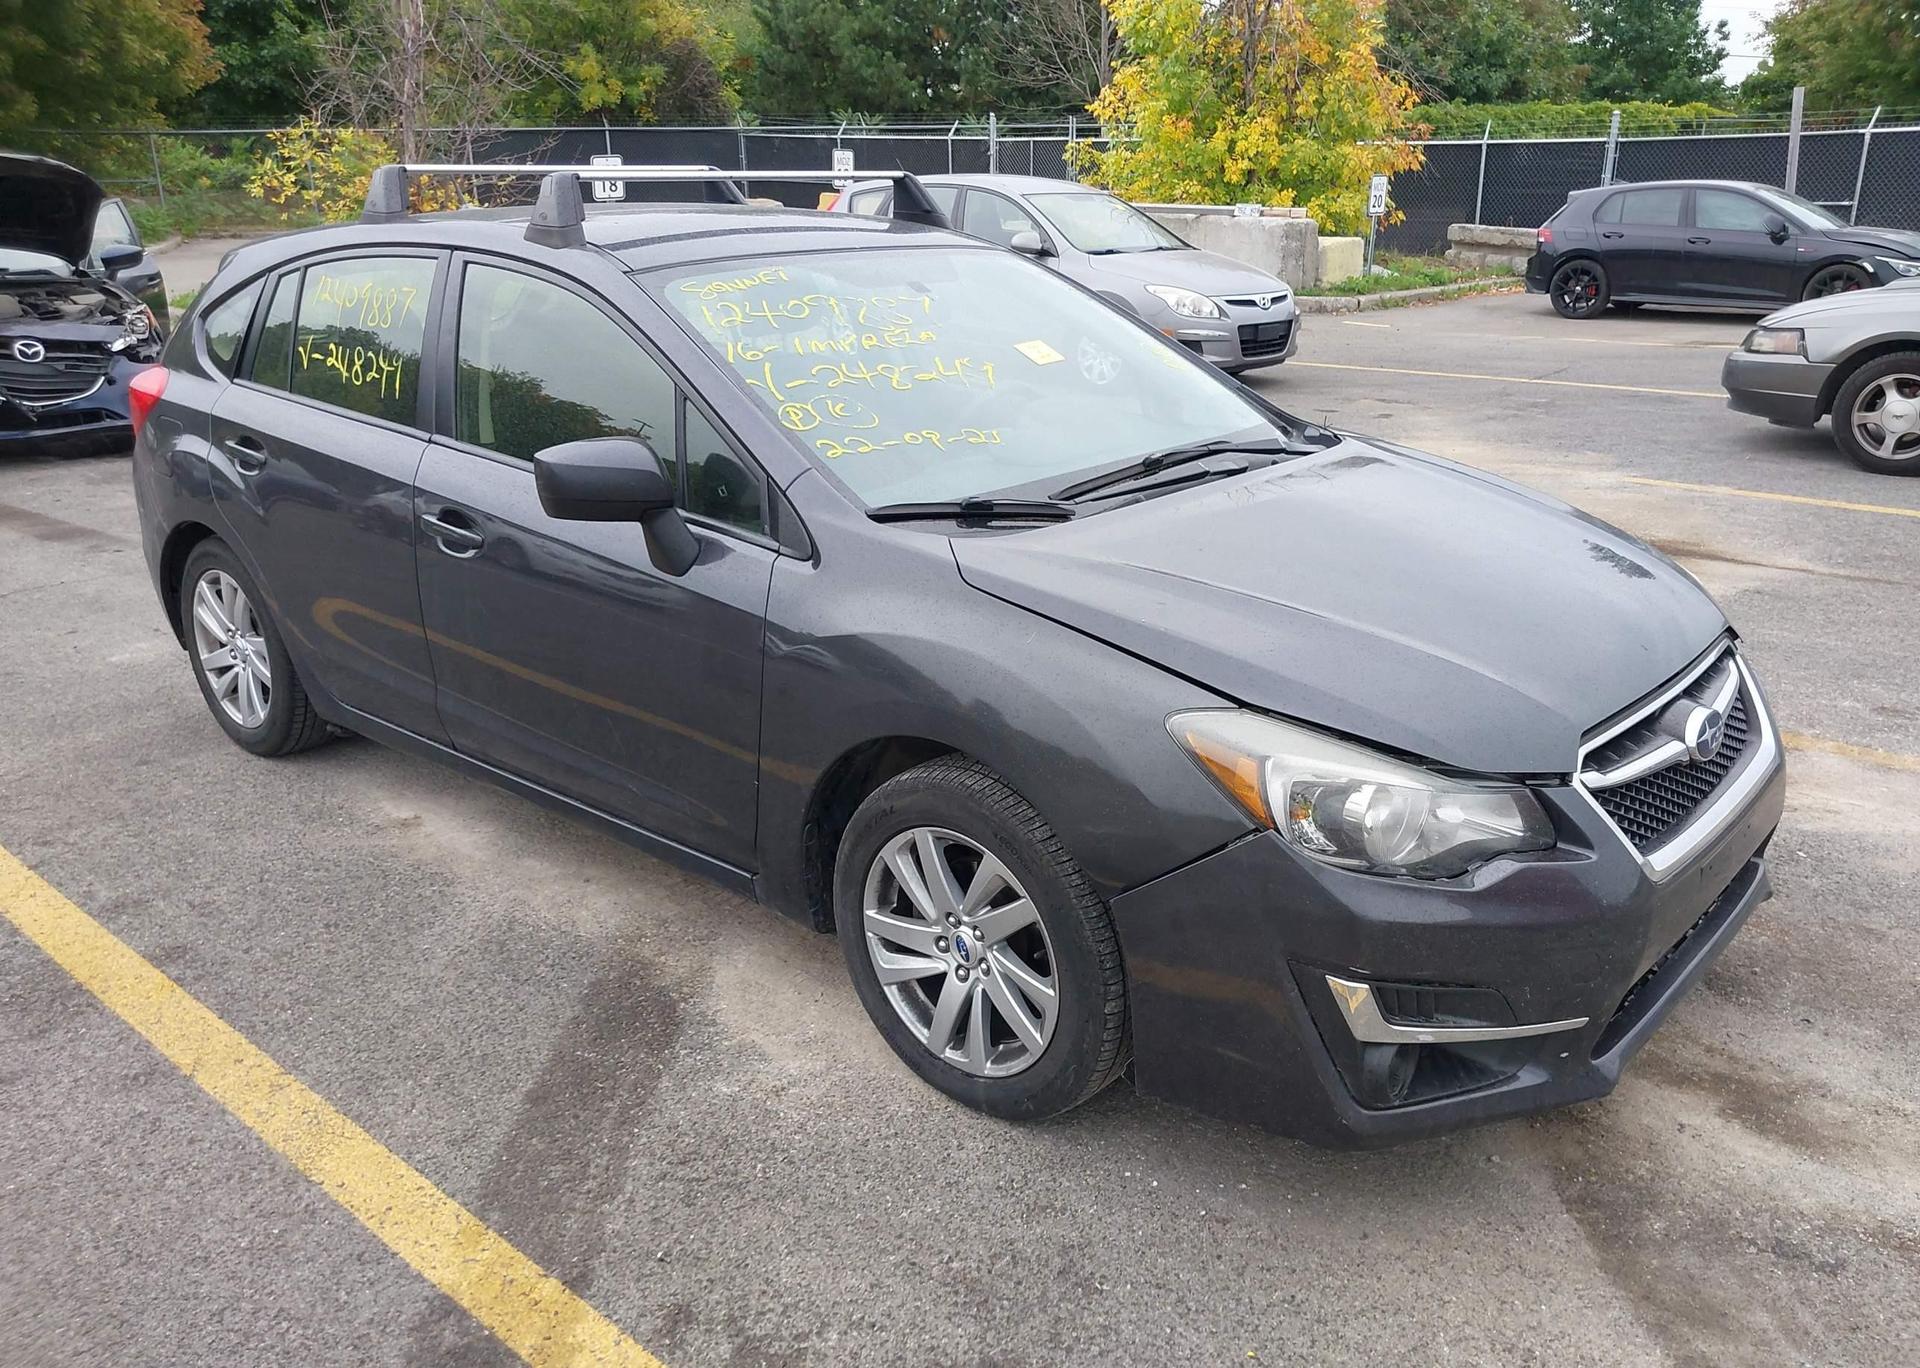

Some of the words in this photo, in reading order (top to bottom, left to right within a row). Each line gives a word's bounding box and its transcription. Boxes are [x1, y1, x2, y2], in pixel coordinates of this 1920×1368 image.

[602, 178, 618, 193] 18
[1372, 194, 1383, 208] 20
[312, 275, 417, 328] 12409887
[298, 335, 402, 400] V-248249
